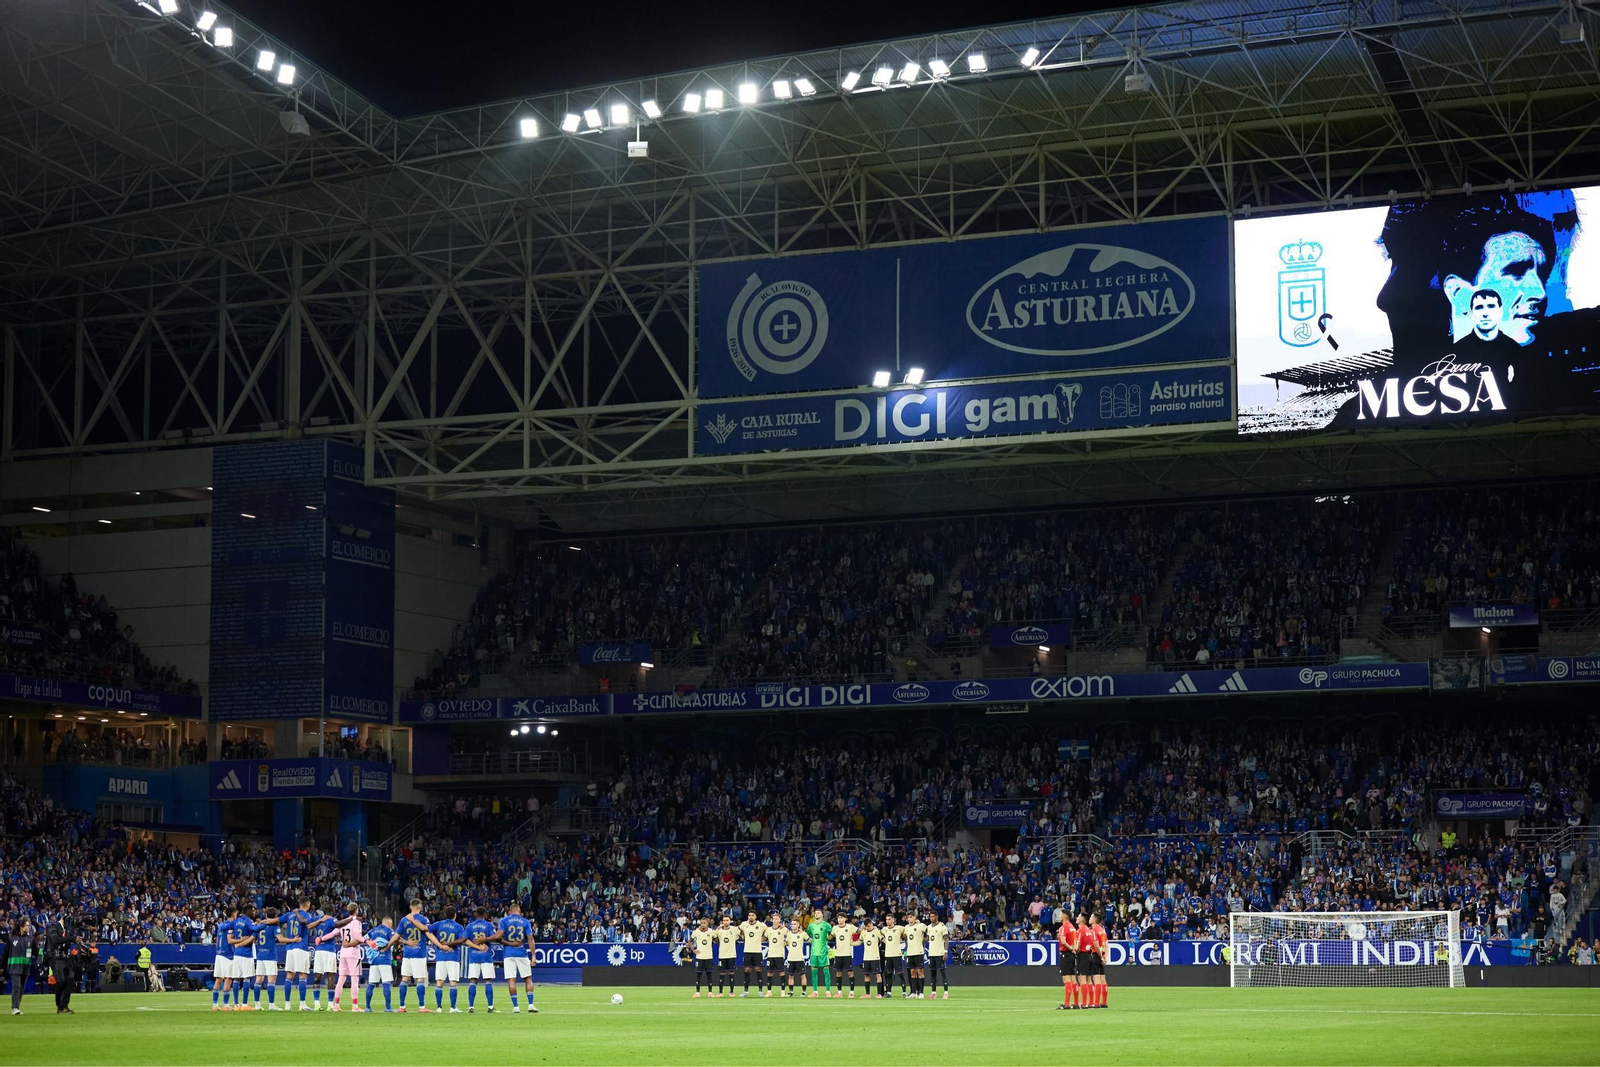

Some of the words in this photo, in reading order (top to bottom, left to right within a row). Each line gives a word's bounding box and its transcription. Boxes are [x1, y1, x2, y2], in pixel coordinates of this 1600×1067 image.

[1018, 280, 1088, 295] CENTRAL
[1095, 272, 1169, 288] LECHERA
[981, 288, 1180, 331] ASTURIANA
[1150, 380, 1224, 400] Asturias
[1357, 371, 1507, 420] MESA
[1190, 398, 1224, 409] natural
[741, 414, 774, 428] CAJA
[776, 412, 821, 427] RURAL
[835, 391, 946, 442] DIGI
[965, 393, 1059, 432] gam
[742, 431, 754, 440] DE
[756, 428, 798, 438] ASTURIAS
[333, 459, 344, 473] EL
[345, 461, 390, 479] COMCIO
[332, 540, 344, 555] EL
[344, 542, 390, 563] COMERCIO
[1473, 607, 1514, 618] Mahou
[332, 621, 344, 636] EL
[344, 623, 390, 643] COMERCIO
[1014, 633, 1046, 641] ASTURIANA
[1332, 671, 1360, 681] GRUPO
[1361, 668, 1400, 679] PACHUCA
[34, 678, 41, 696] de
[896, 690, 927, 698] ASTURIANA
[956, 689, 987, 697] ASTURIANA
[1031, 675, 1114, 699] exiom
[87, 685, 131, 706] copun
[761, 686, 809, 708] DIGI
[821, 684, 871, 706] DIGI
[330, 695, 341, 709] EL
[342, 696, 388, 715] COMERCIO
[439, 699, 492, 712] OVIEDO
[533, 698, 600, 714] CaixaBank
[274, 777, 295, 785] Tienda
[296, 777, 314, 785] Oficial
[362, 780, 375, 788] Tienda
[1466, 800, 1491, 808] GRUPO
[992, 809, 1013, 818] GRUPO
[290, 919, 300, 936] 16
[341, 928, 352, 943] 13
[406, 927, 421, 943] 20
[508, 925, 525, 942] 23
[259, 930, 266, 946] 5
[439, 930, 455, 944] 24
[630, 949, 645, 961] bp
